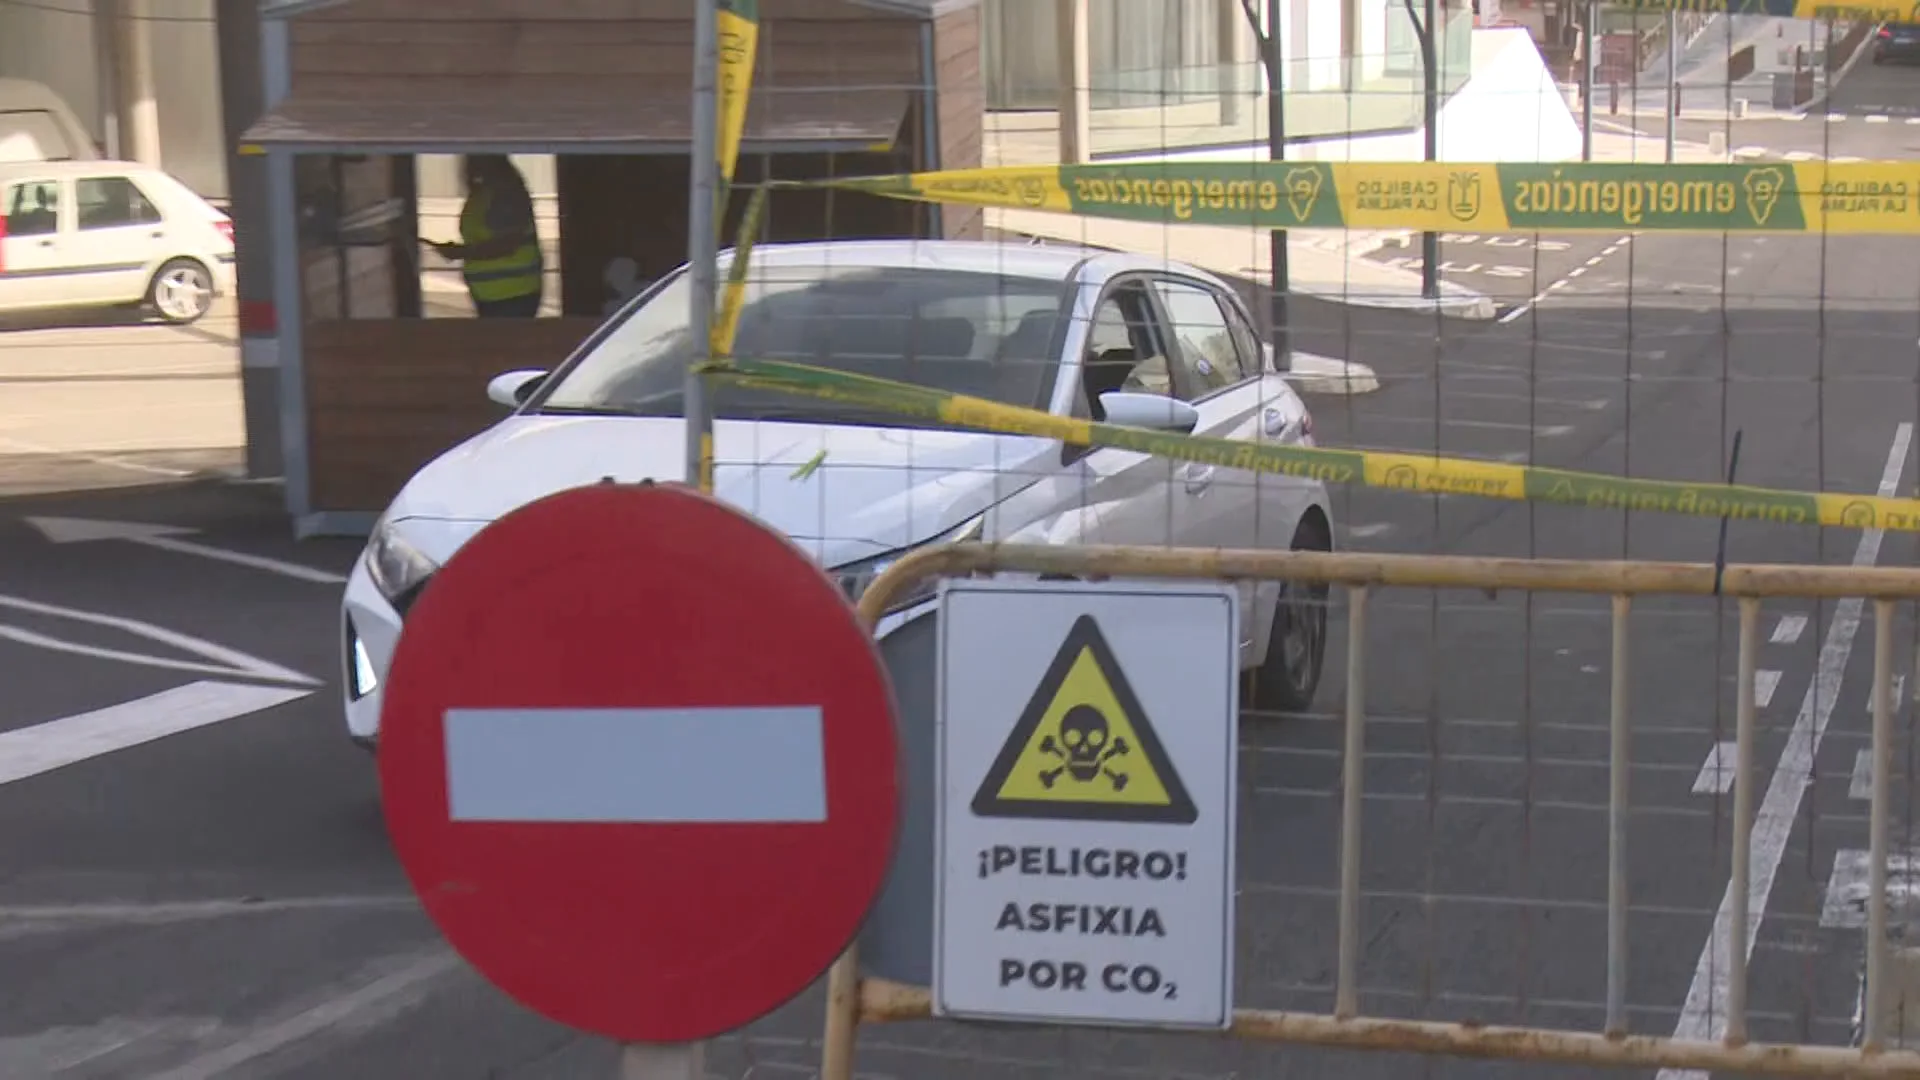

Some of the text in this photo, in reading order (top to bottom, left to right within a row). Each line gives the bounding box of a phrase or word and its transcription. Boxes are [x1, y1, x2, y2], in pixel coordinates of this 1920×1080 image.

[978, 844, 1188, 881] ¡PELIGRO!
[995, 902, 1167, 937] ASFIXIA
[1000, 959, 1088, 991] POR
